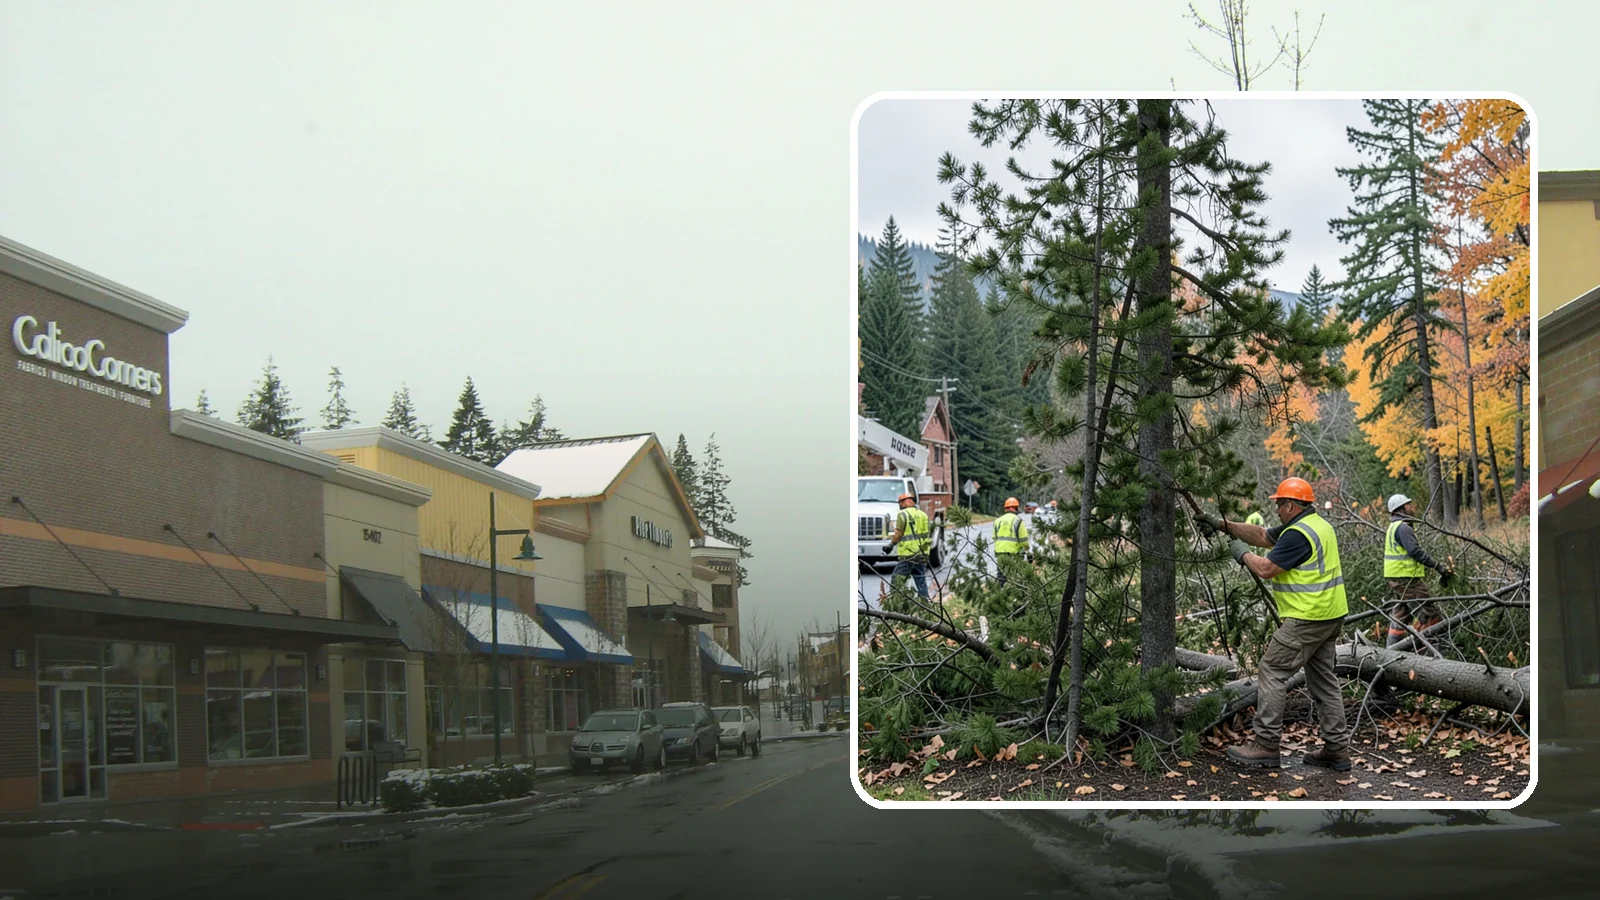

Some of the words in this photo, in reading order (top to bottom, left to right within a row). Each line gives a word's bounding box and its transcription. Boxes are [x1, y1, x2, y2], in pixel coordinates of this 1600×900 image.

[16, 360, 47, 376] FABRICS
[51, 369, 78, 386] WINDOW
[78, 378, 116, 398] TREATMENTS
[119, 391, 151, 409] FURNITURE
